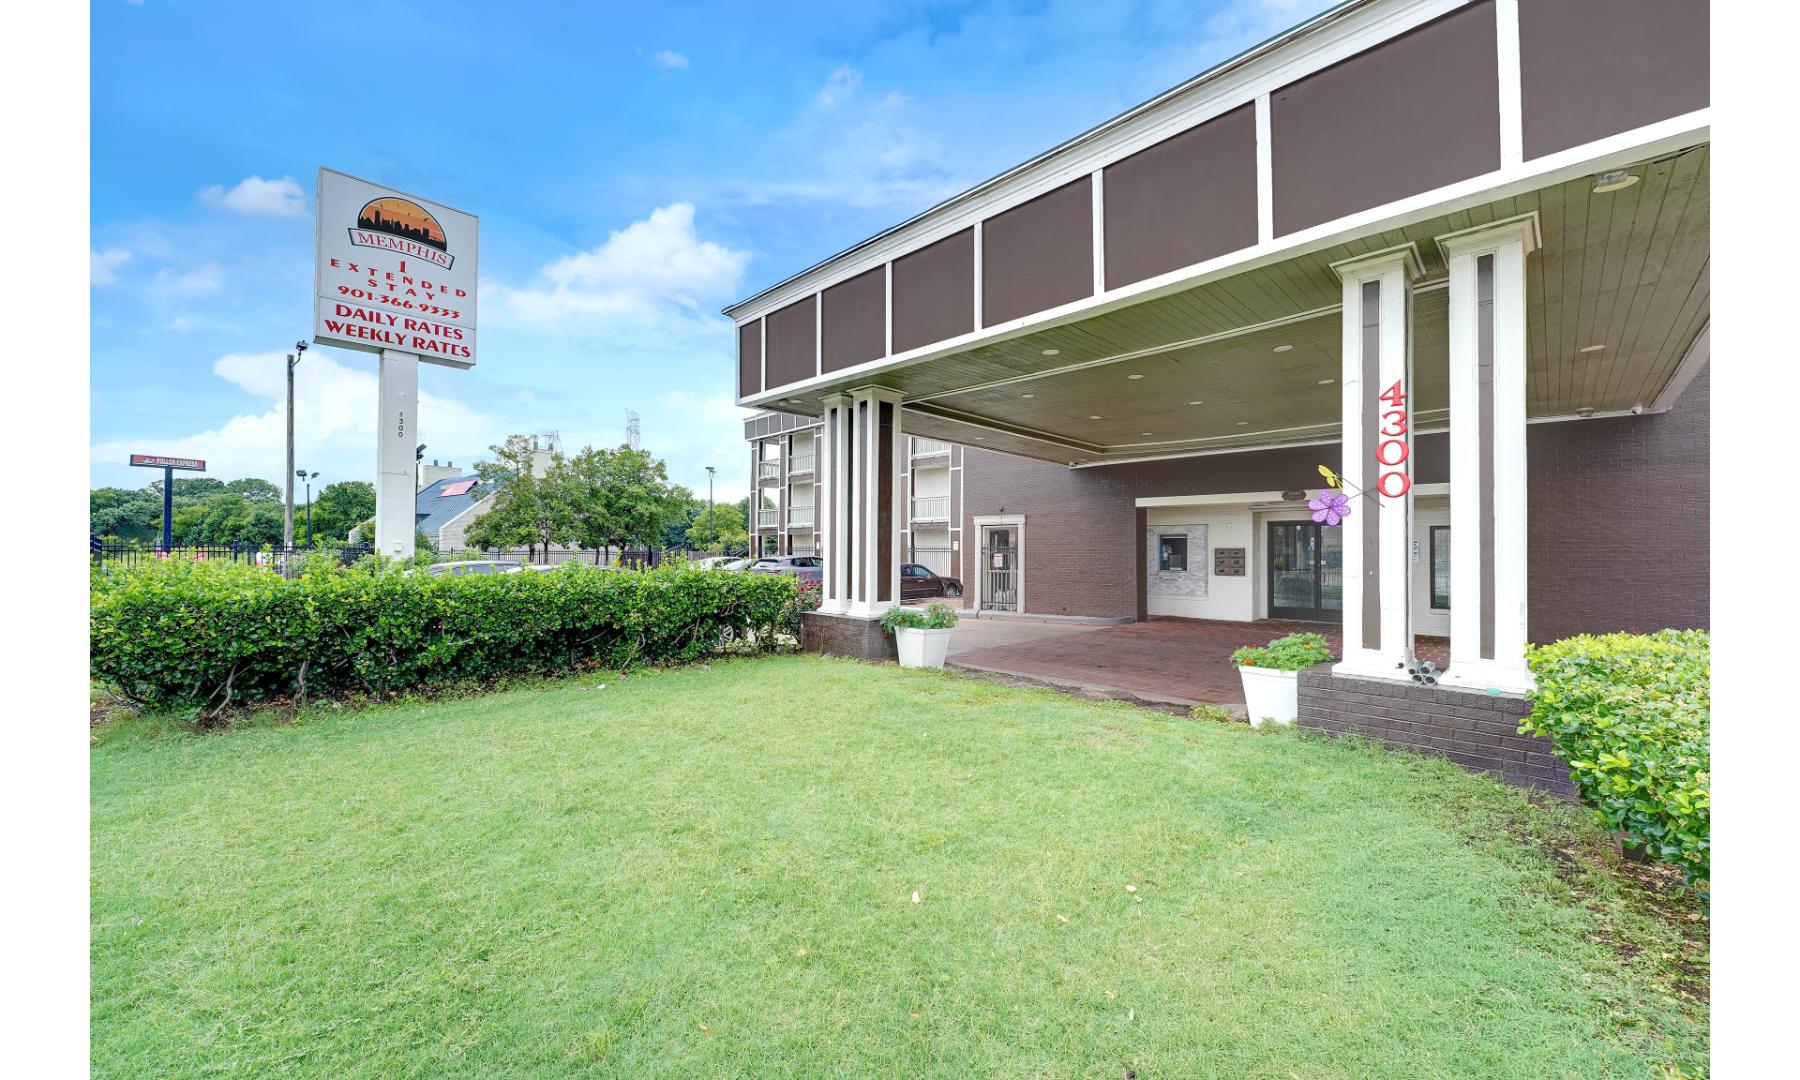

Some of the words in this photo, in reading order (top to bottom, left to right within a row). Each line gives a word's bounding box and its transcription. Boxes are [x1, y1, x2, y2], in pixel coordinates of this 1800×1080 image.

[358, 232, 447, 265] MEMPHIS
[330, 258, 466, 297] EXTENDED
[399, 260, 406, 273] 1
[338, 285, 460, 319] 901-366-9333
[368, 278, 435, 301] STAY
[324, 319, 408, 346] WEEKLY
[335, 304, 398, 327] DAILY
[404, 318, 463, 340] RATES
[1375, 379, 1410, 498] 4300
